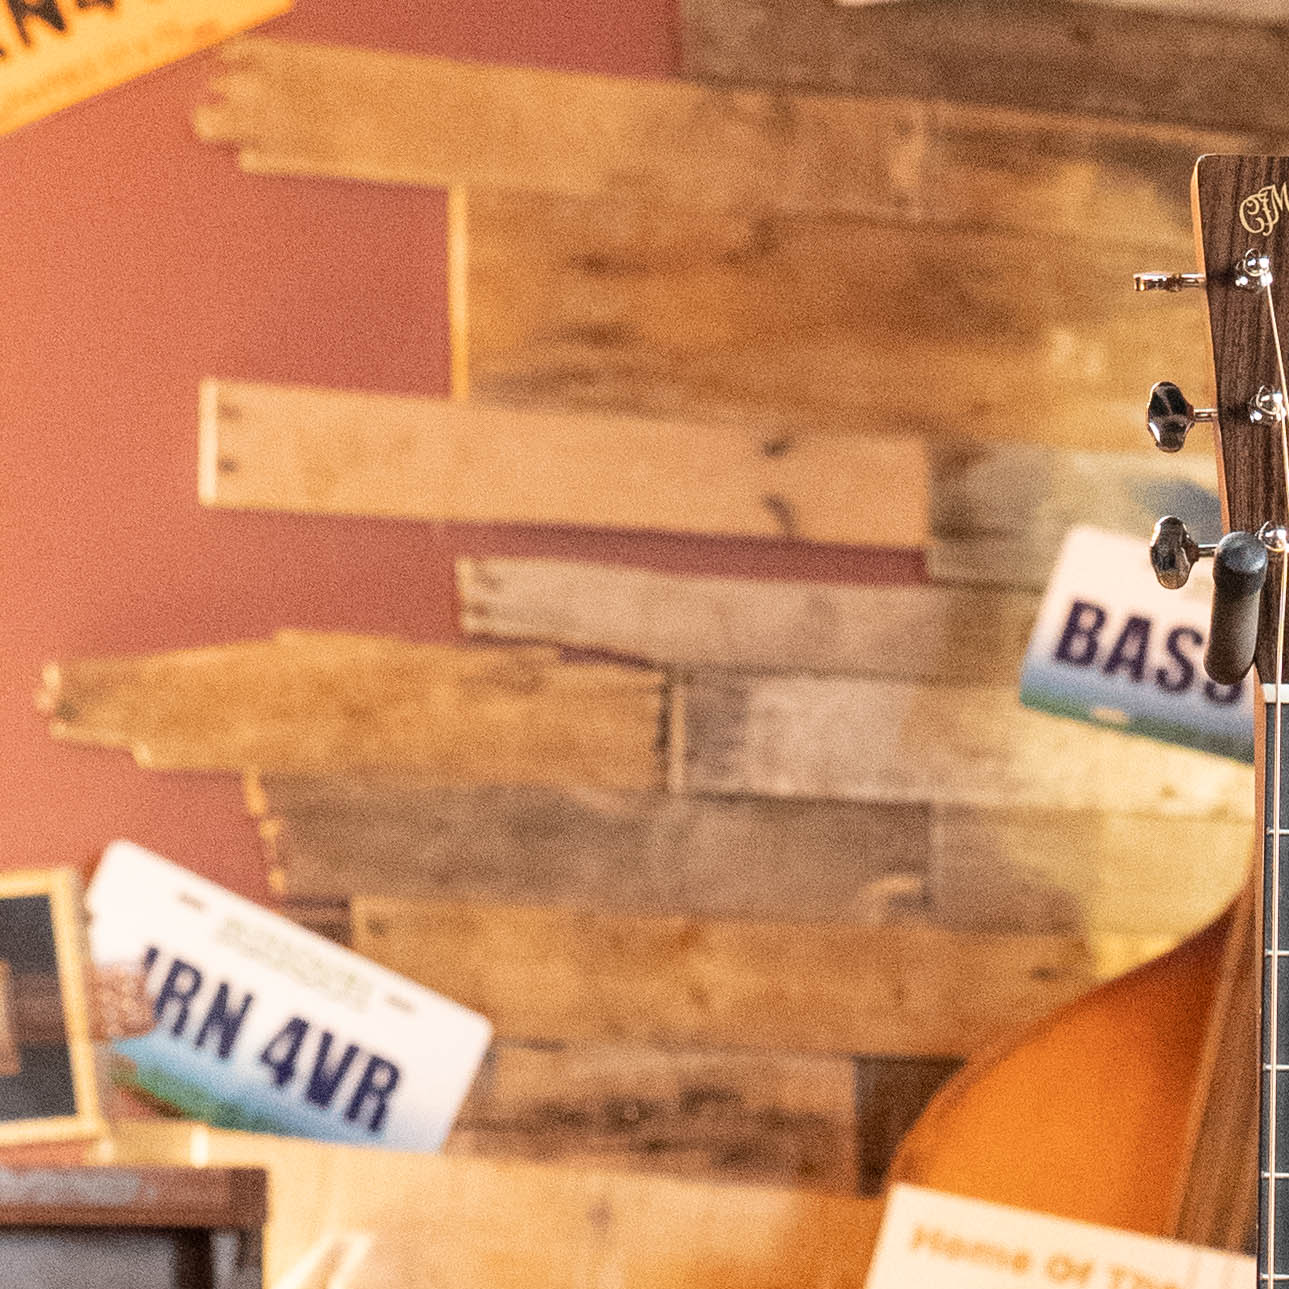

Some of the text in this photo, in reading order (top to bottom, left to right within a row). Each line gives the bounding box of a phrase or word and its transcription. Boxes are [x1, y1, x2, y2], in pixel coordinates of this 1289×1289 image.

[143, 946, 255, 1061] RN
[258, 1016, 402, 1135] 4VR
[911, 1224, 1032, 1275] Home
